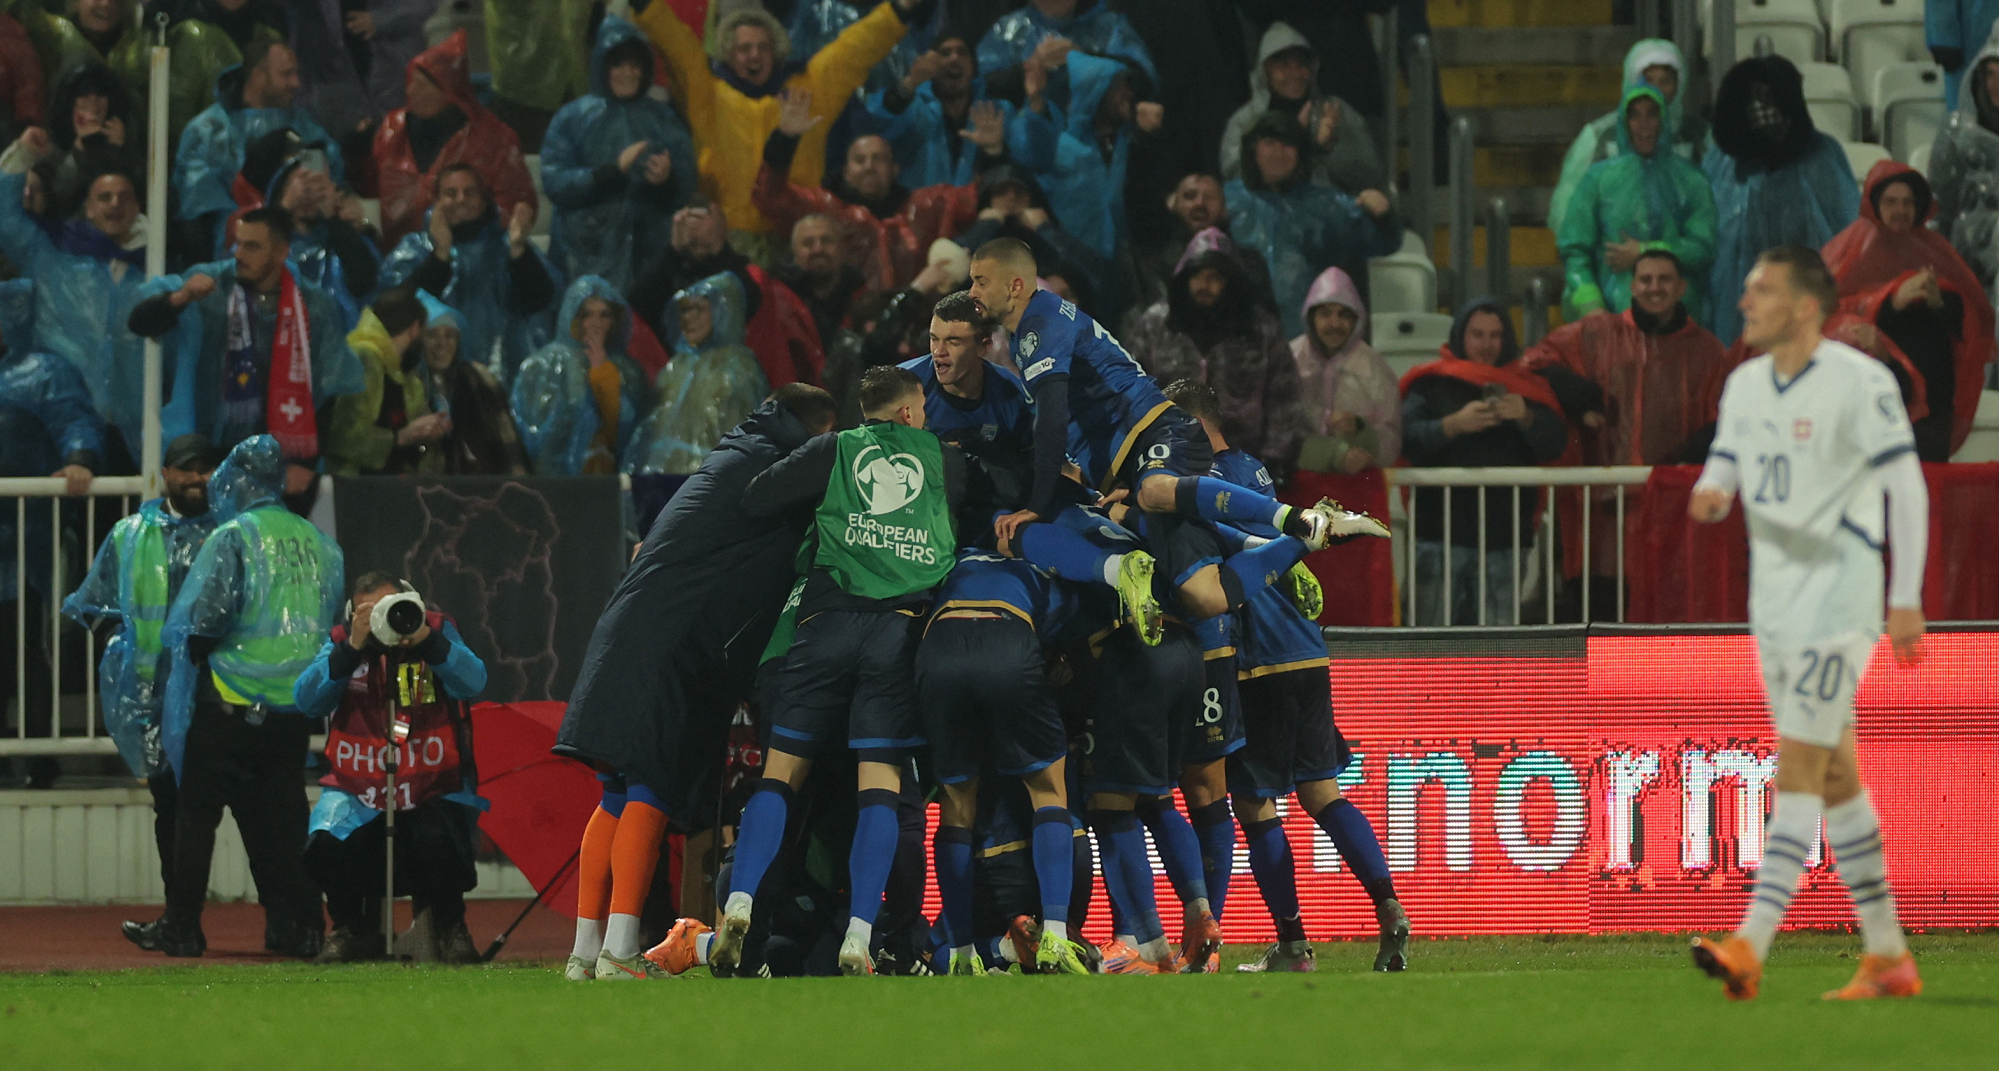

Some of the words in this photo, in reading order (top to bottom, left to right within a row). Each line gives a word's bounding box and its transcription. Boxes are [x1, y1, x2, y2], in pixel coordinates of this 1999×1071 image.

[1755, 452, 1790, 503] 20
[848, 511, 928, 544] EUROPEAN
[1796, 650, 1844, 701] 20
[336, 736, 444, 772] PHOTO
